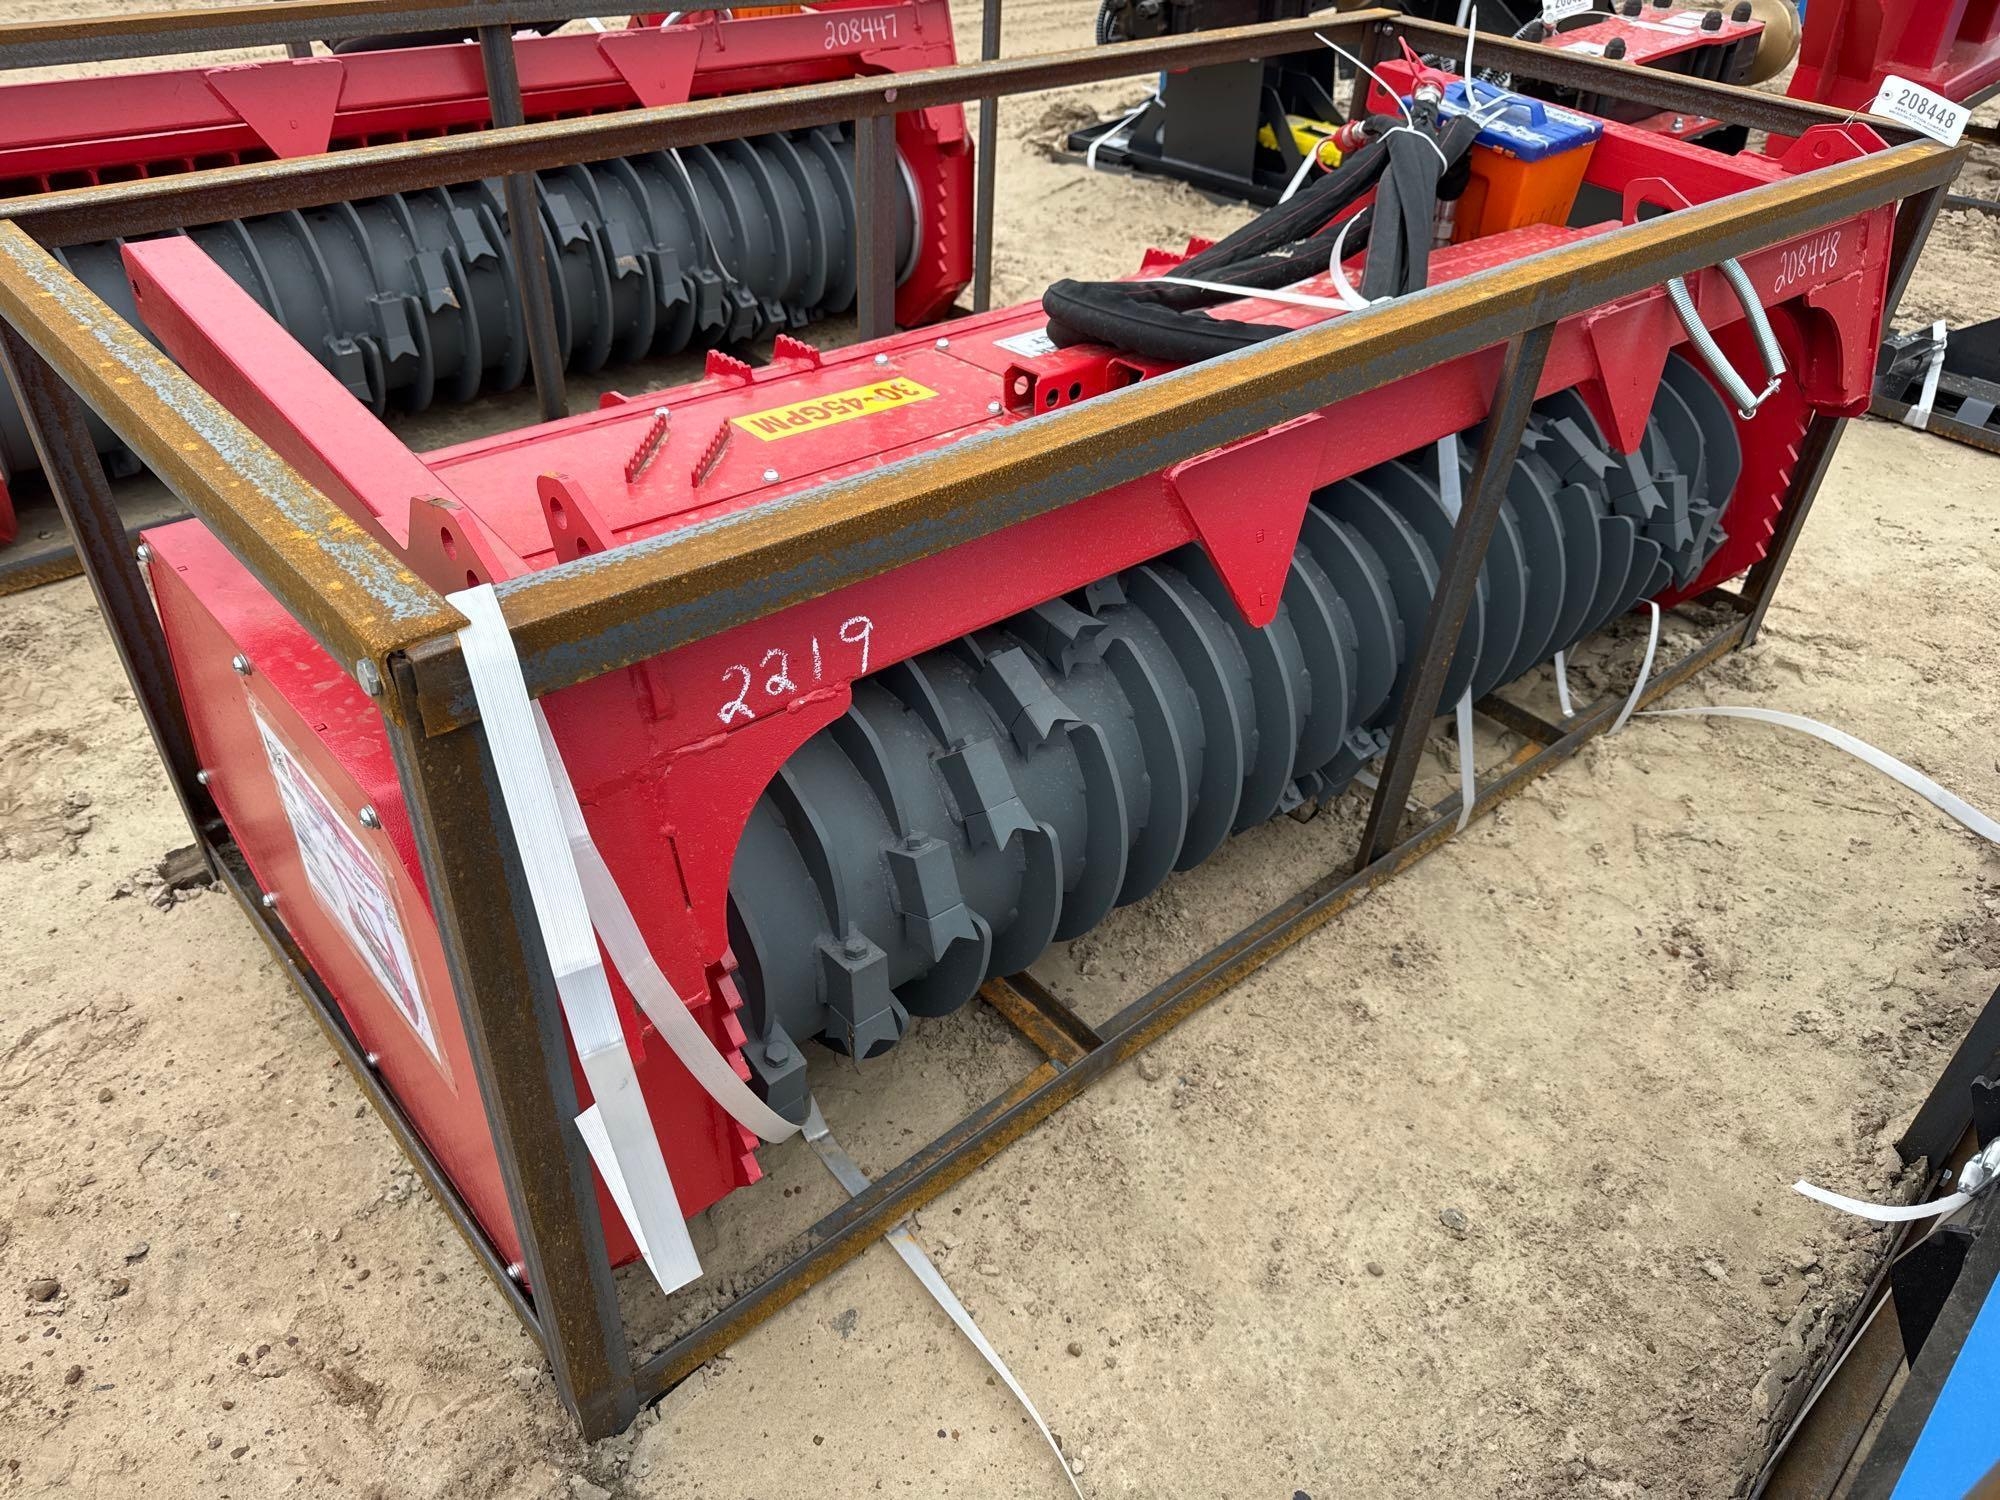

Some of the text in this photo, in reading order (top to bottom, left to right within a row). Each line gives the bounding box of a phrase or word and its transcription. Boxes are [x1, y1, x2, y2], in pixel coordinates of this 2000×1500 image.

[824, 13, 897, 51] 208447
[1897, 88, 1957, 129] 208448
[1774, 231, 1841, 294] 208448
[717, 615, 874, 724] 2219
